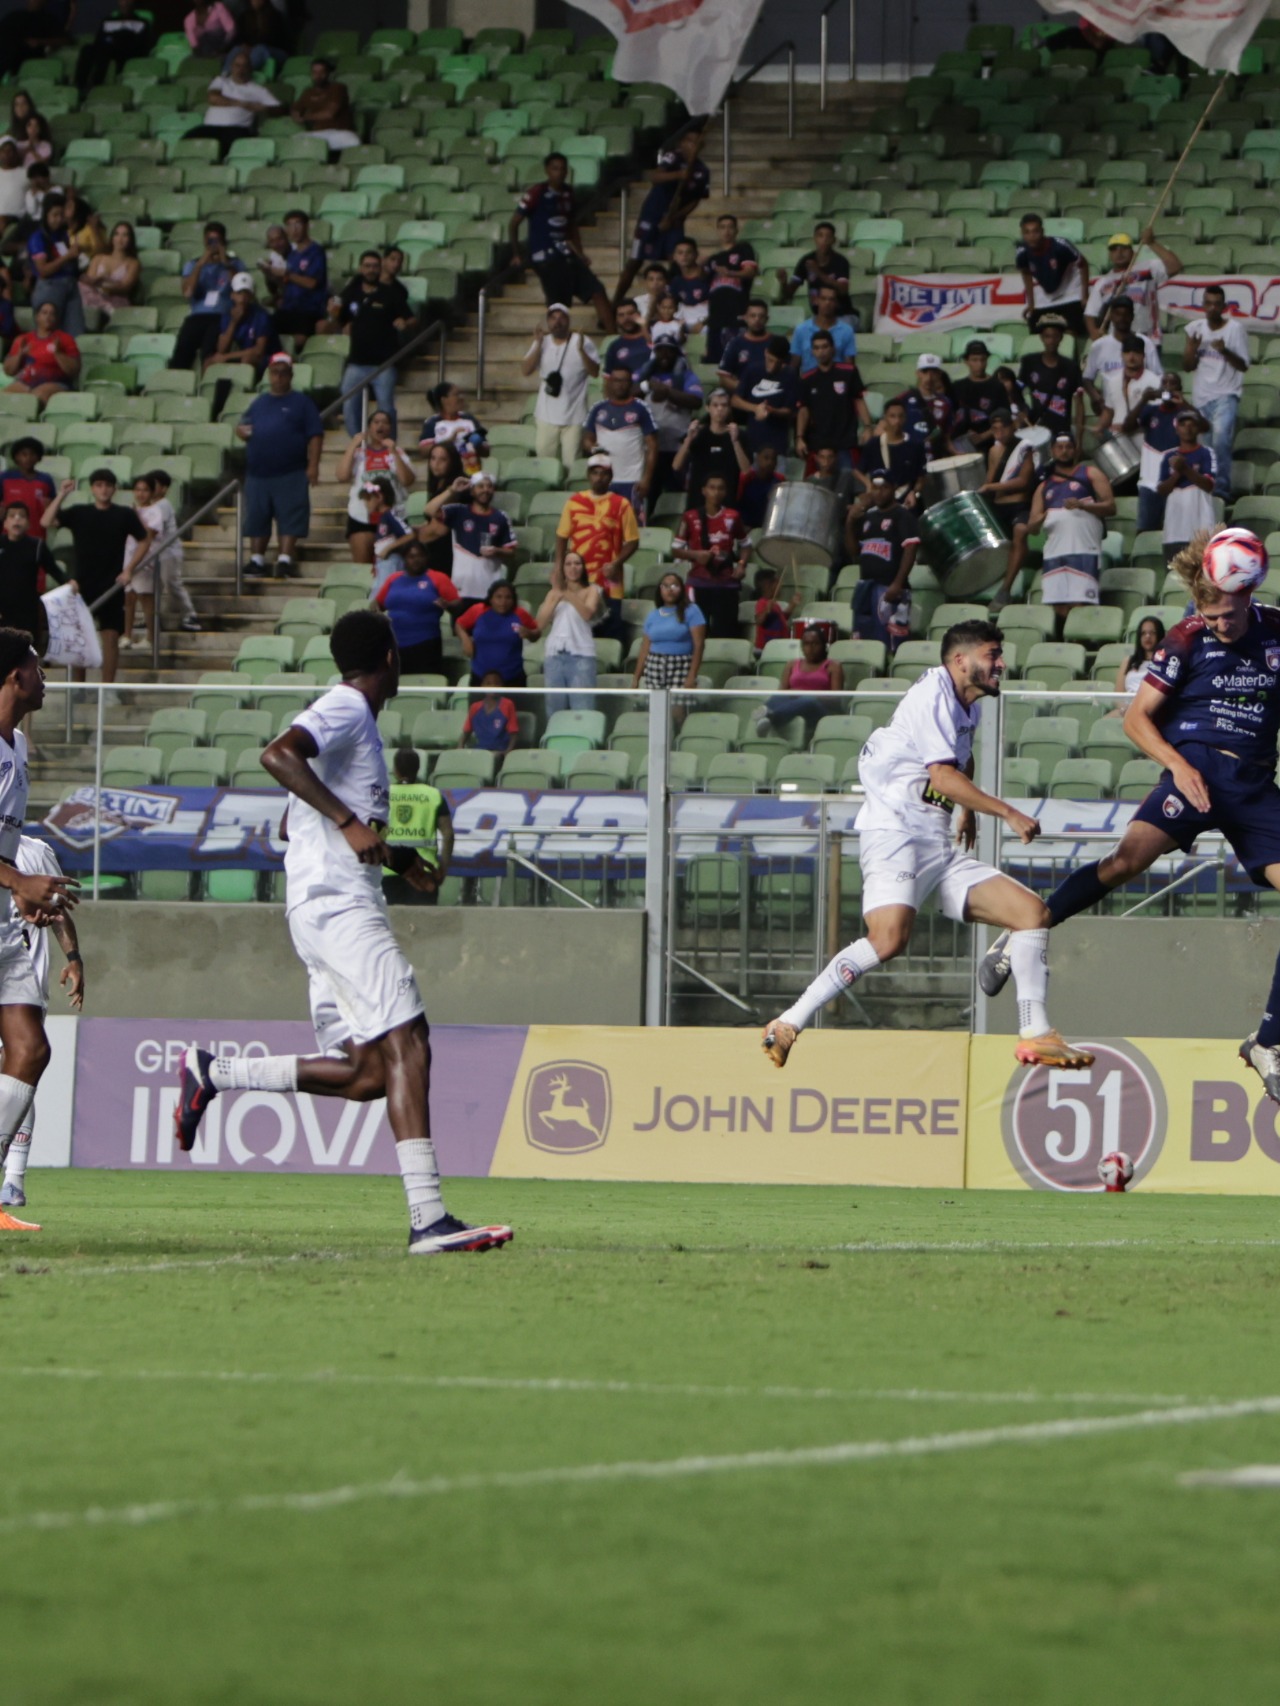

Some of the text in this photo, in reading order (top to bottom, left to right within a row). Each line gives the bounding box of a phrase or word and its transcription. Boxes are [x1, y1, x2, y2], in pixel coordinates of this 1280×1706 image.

[890, 285, 987, 306] BETIM
[1209, 705, 1236, 718] Crafting
[389, 793, 430, 804] GURANÇA
[633, 1086, 960, 1136] JOHN DEERE
[1045, 1069, 1122, 1163] 51
